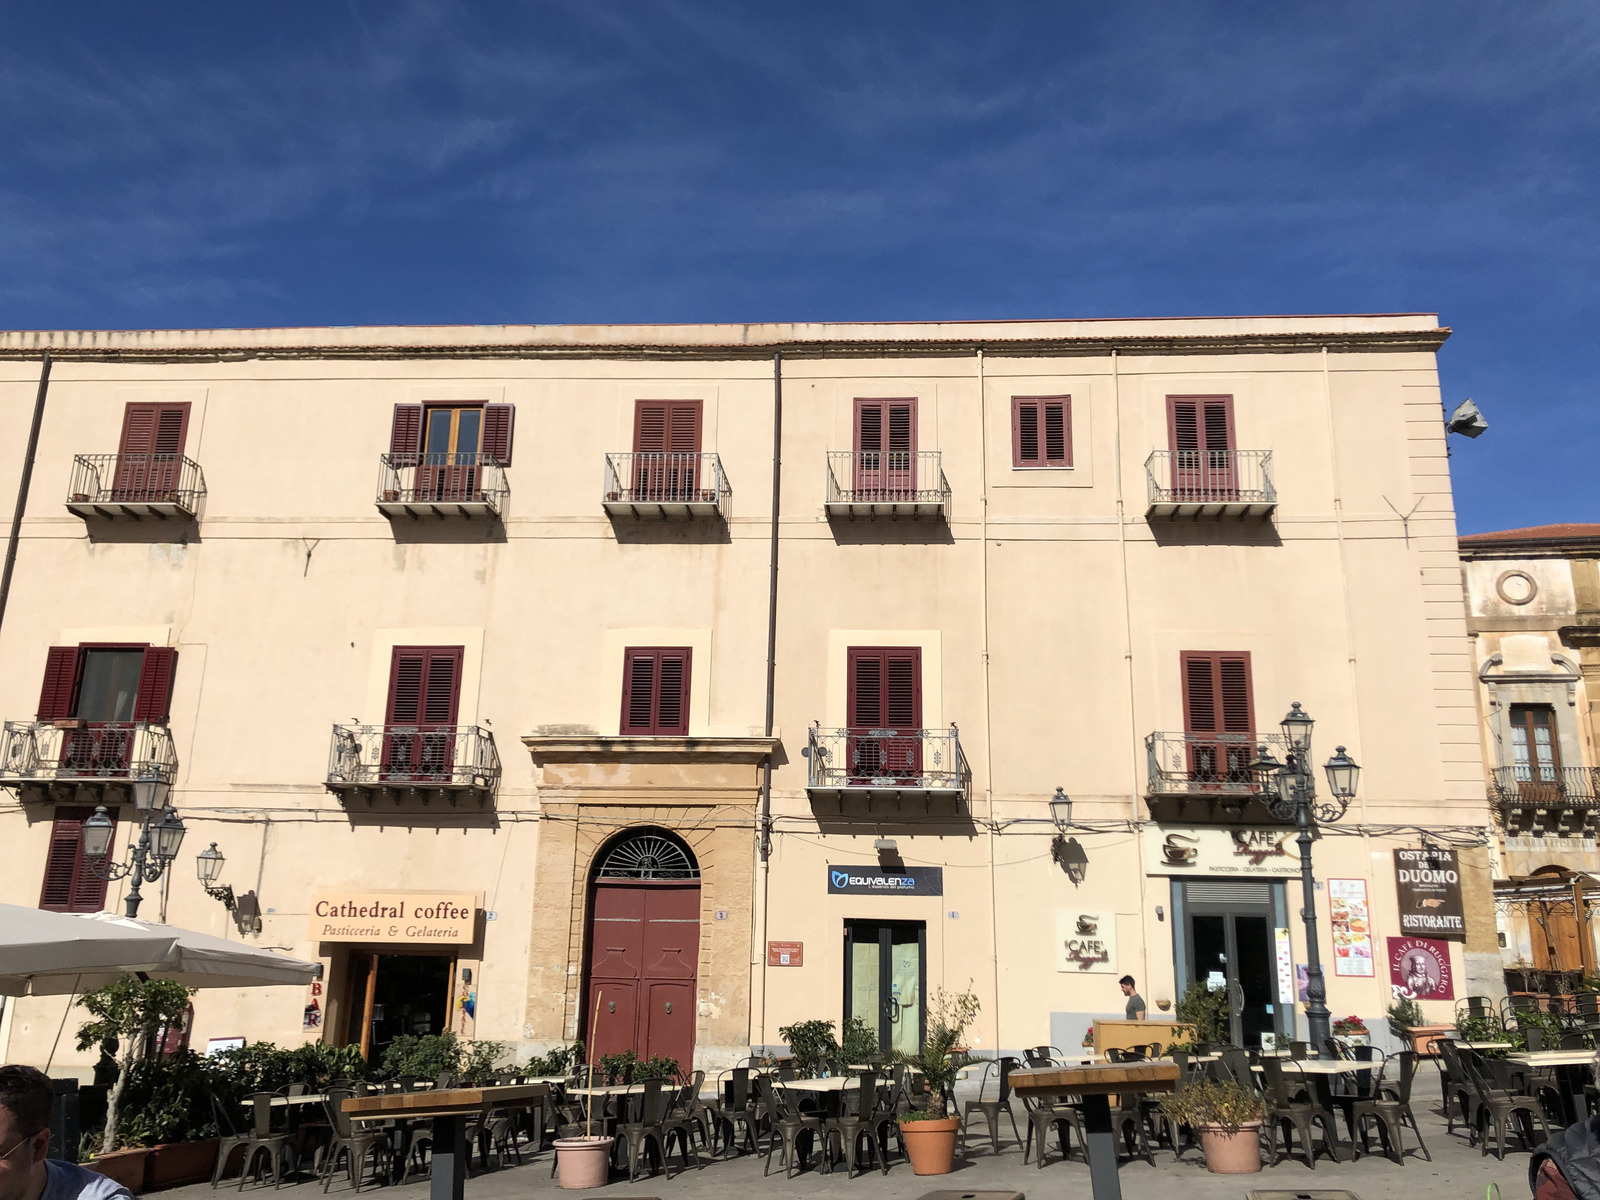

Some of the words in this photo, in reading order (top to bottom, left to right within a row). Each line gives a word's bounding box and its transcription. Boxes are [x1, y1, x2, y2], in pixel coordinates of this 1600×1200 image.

[1398, 869, 1458, 883] DUOMO
[315, 900, 405, 919] Cathedral
[414, 901, 469, 919] coffee
[1402, 914, 1463, 928] RISTORANTE
[322, 924, 381, 936] Pasticceria
[388, 926, 399, 937] &
[405, 925, 459, 938] Gelateria
[1415, 940, 1428, 949] DI
[1428, 946, 1449, 994] RUGGERO
[309, 982, 322, 1027] BAR
